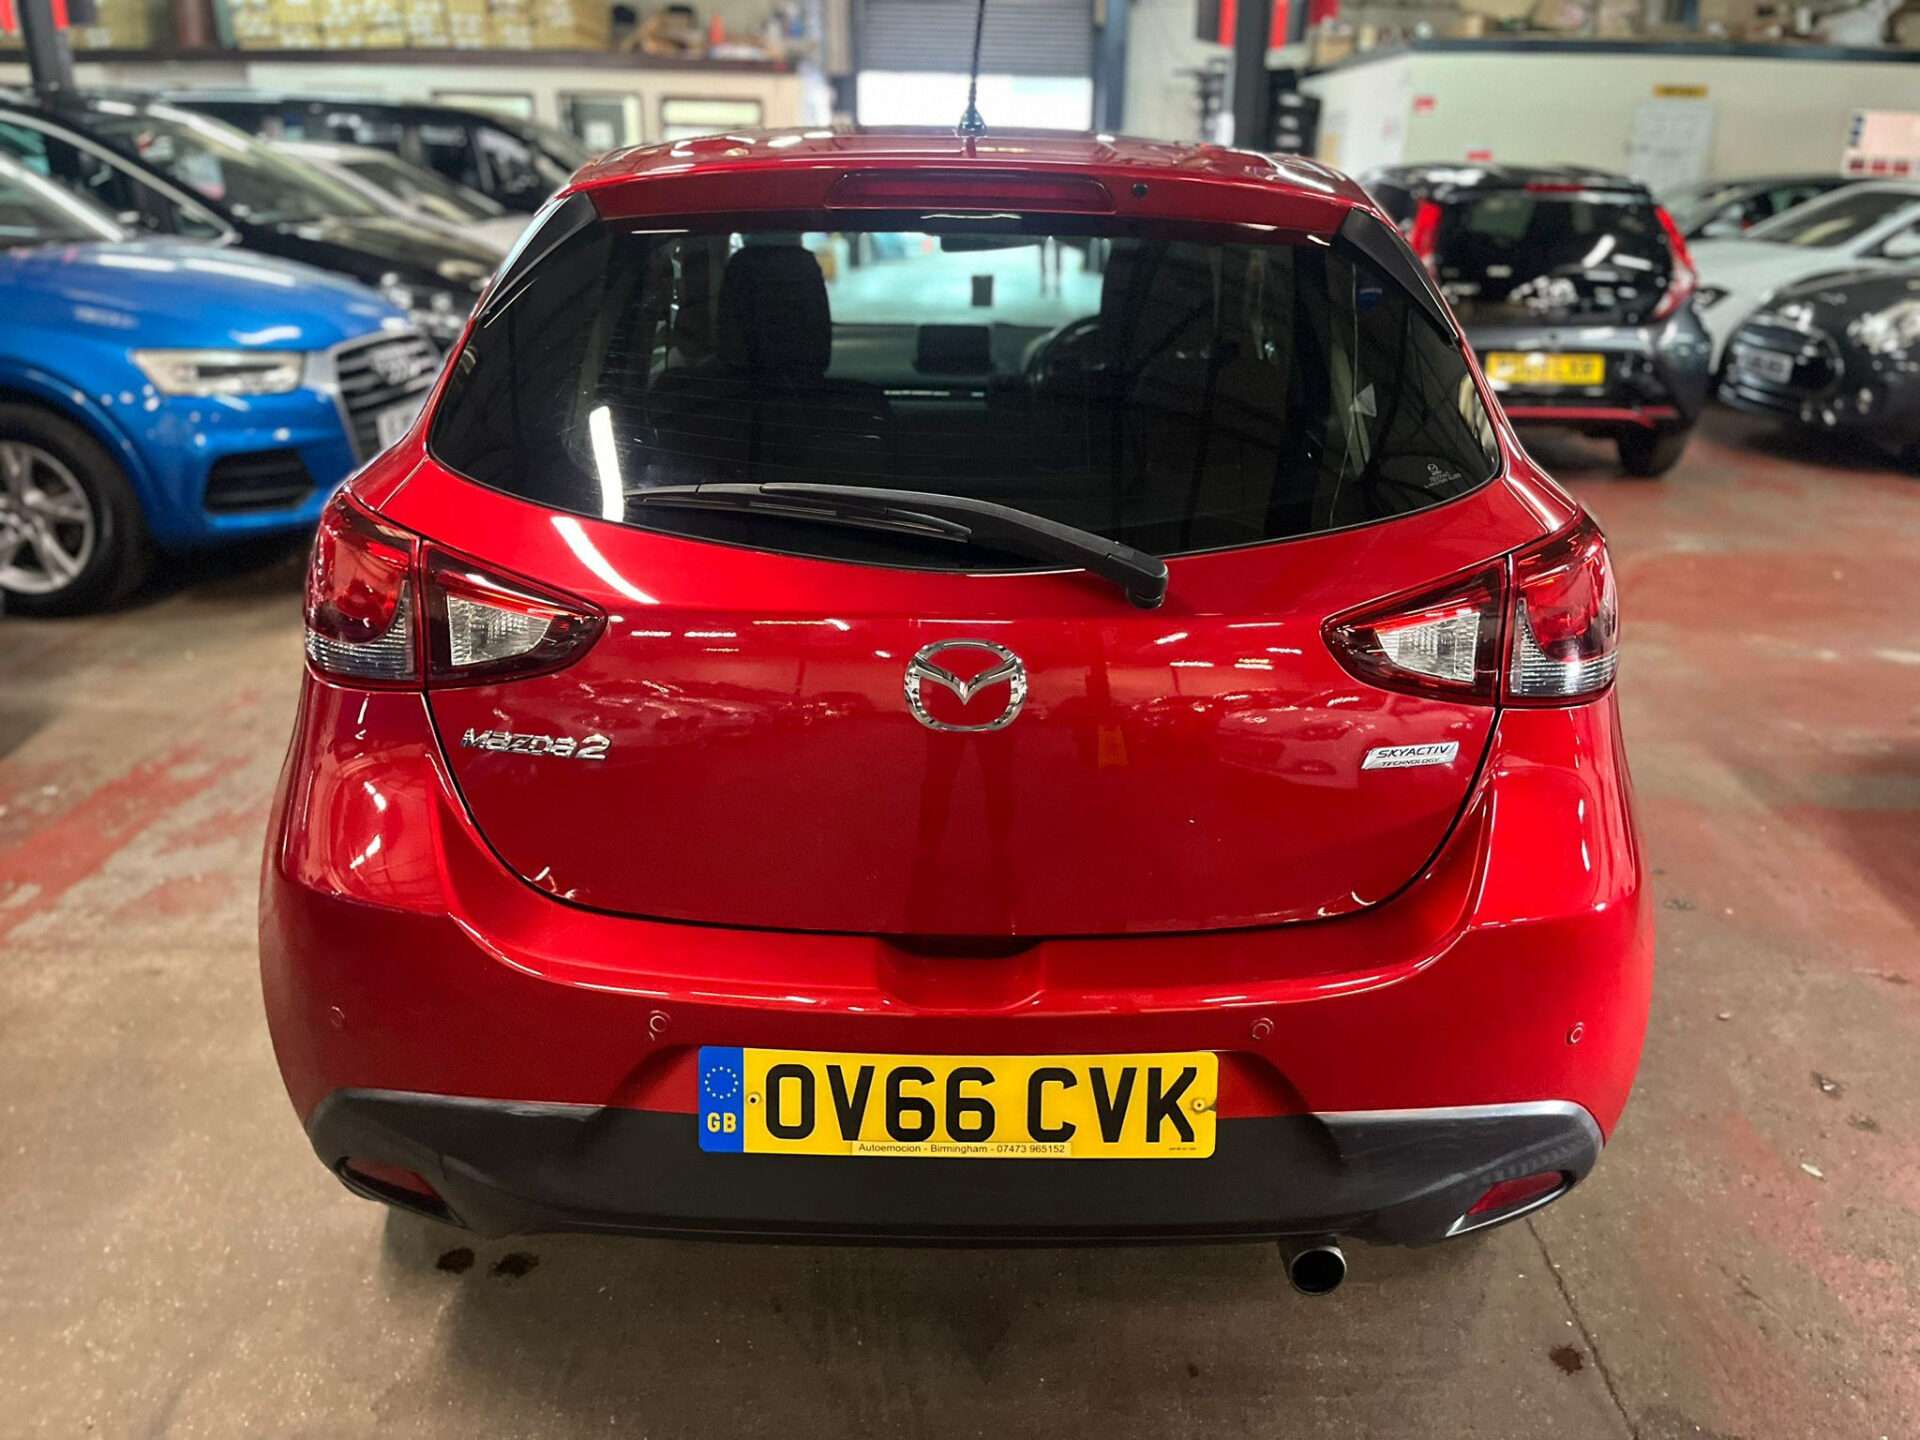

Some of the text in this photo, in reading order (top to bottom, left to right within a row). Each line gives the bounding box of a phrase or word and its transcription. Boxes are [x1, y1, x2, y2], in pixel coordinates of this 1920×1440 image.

[1376, 745, 1450, 759] SKYACTIV
[765, 1063, 1197, 1143] OV66 CVK
[707, 1112, 736, 1133] GB
[858, 1143, 921, 1153] Autoemocion
[931, 1144, 988, 1154] Birmingham
[997, 1145, 1027, 1153] 07473
[1029, 1145, 1065, 1154] 965152
